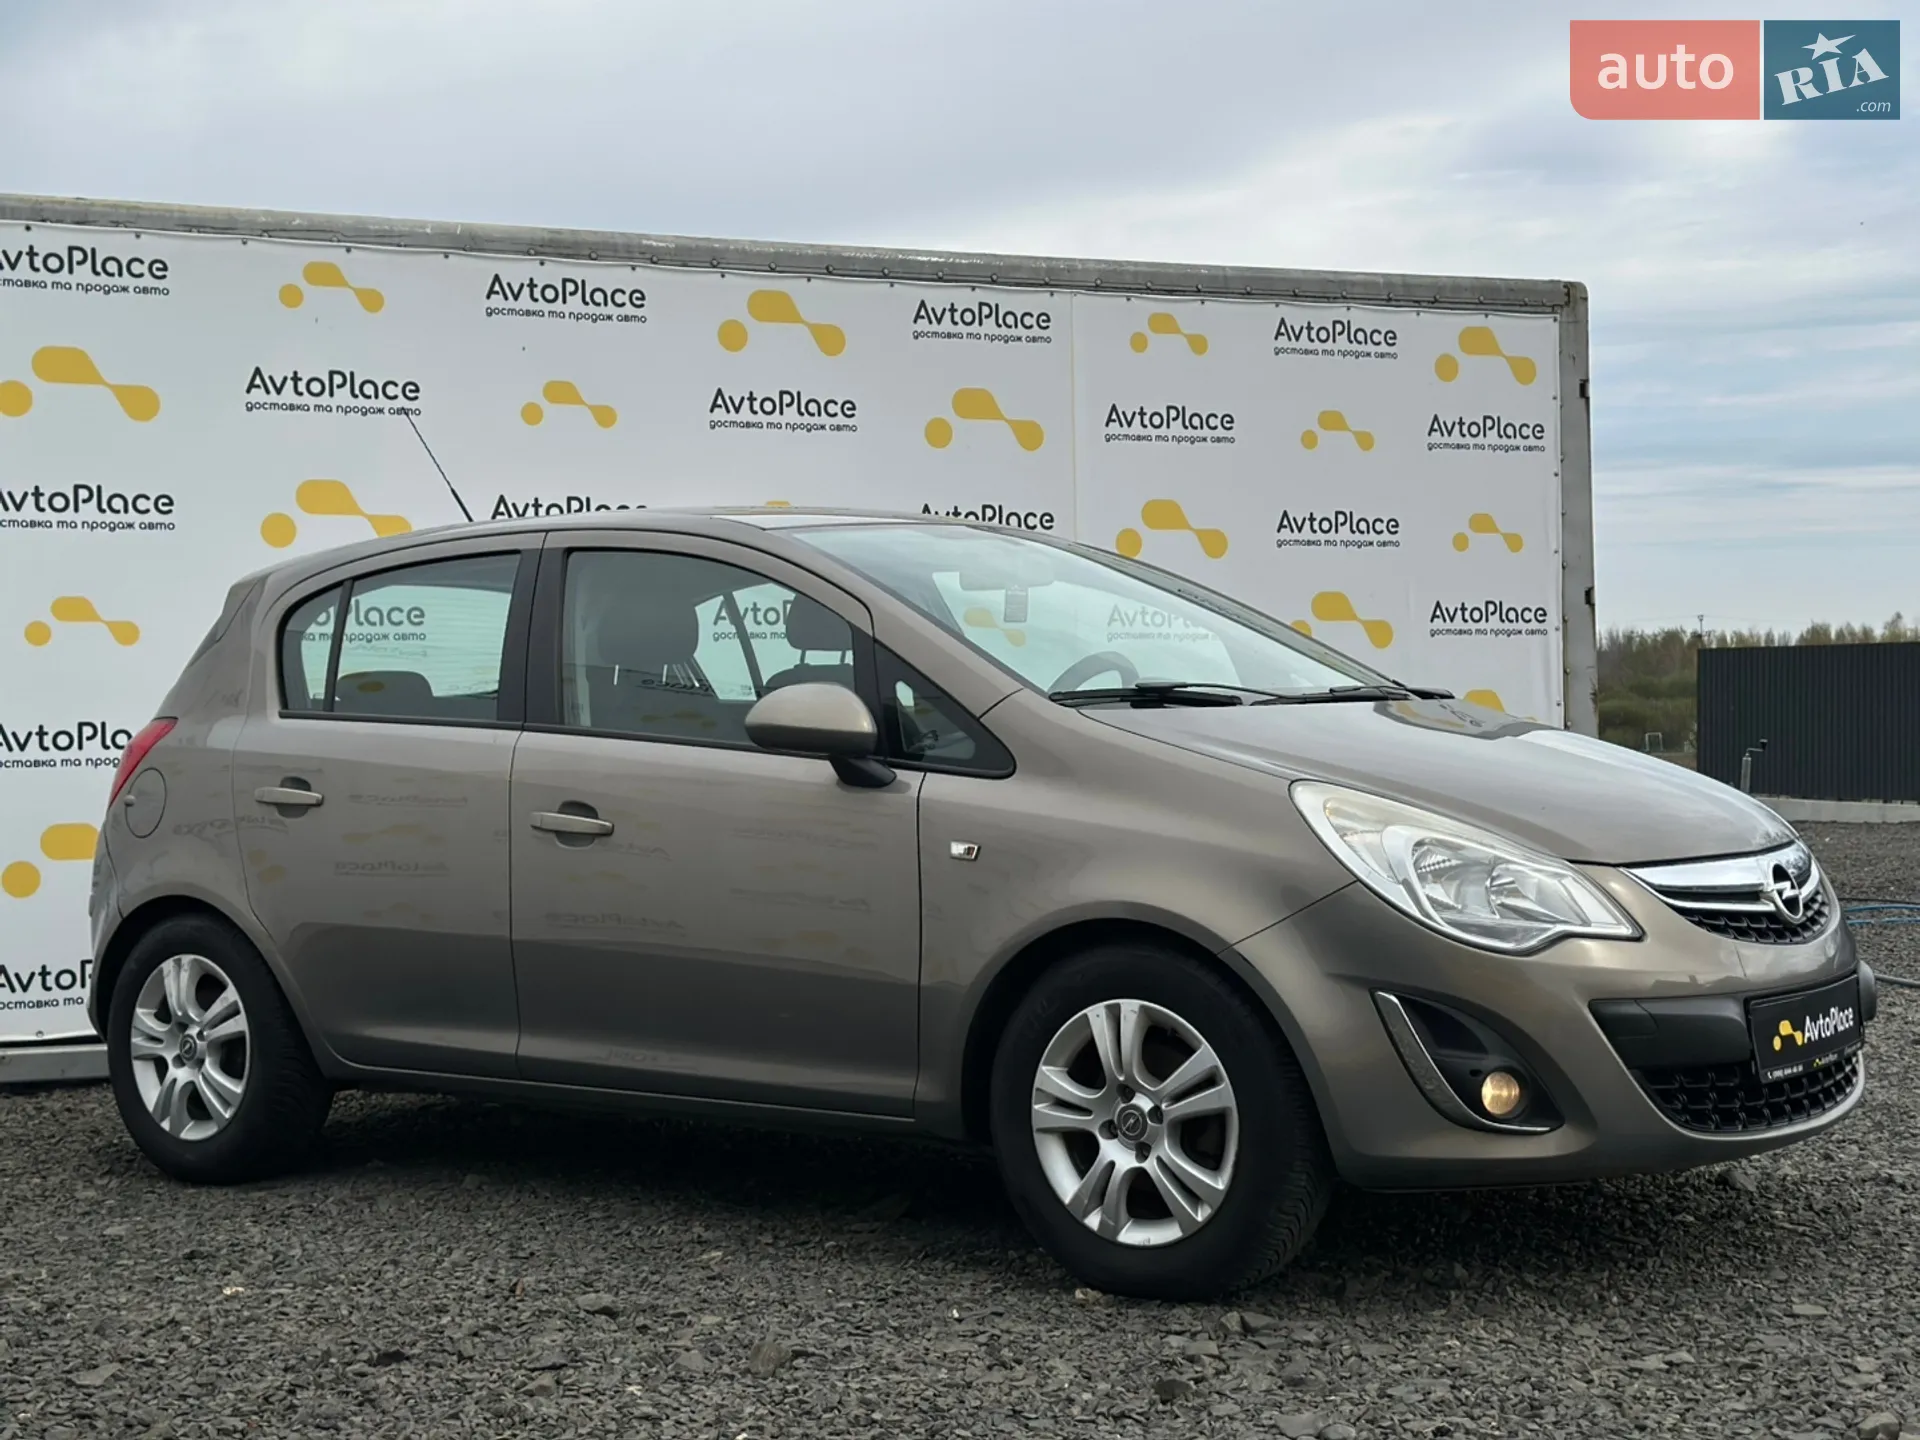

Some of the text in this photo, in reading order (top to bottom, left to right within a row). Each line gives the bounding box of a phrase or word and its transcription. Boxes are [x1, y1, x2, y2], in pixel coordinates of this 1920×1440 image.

[0, 245, 168, 280] vtoPlace
[51, 280, 72, 291] та
[76, 282, 130, 295] продаж
[133, 285, 170, 296] авто
[485, 273, 646, 308] AvtoPlace
[485, 306, 647, 323] доставка та продаж авто
[913, 299, 1051, 330] AvtoPlace
[912, 330, 1052, 344] доставка та продаж авто
[1274, 317, 1397, 347] AvtoPlace
[245, 366, 420, 401] AvtoPlace
[245, 401, 310, 412] доставка
[313, 403, 333, 413] та
[336, 404, 385, 416] продаж
[709, 387, 857, 418] AvtoPlace
[709, 419, 858, 433] доставка та продаж авто
[1105, 403, 1235, 431] AvtoPlace
[1427, 413, 1545, 440] AvtoPlace
[57, 519, 78, 529] та
[81, 519, 135, 532] продаж
[138, 520, 175, 531] авто
[1276, 509, 1399, 535] AvtoPlace
[1430, 600, 1547, 624] AvtoPlace
[393, 632, 427, 642] авто
[60, 757, 81, 767] та
[63, 997, 84, 1006] та
[1804, 1006, 1854, 1044] AvtoPlace
